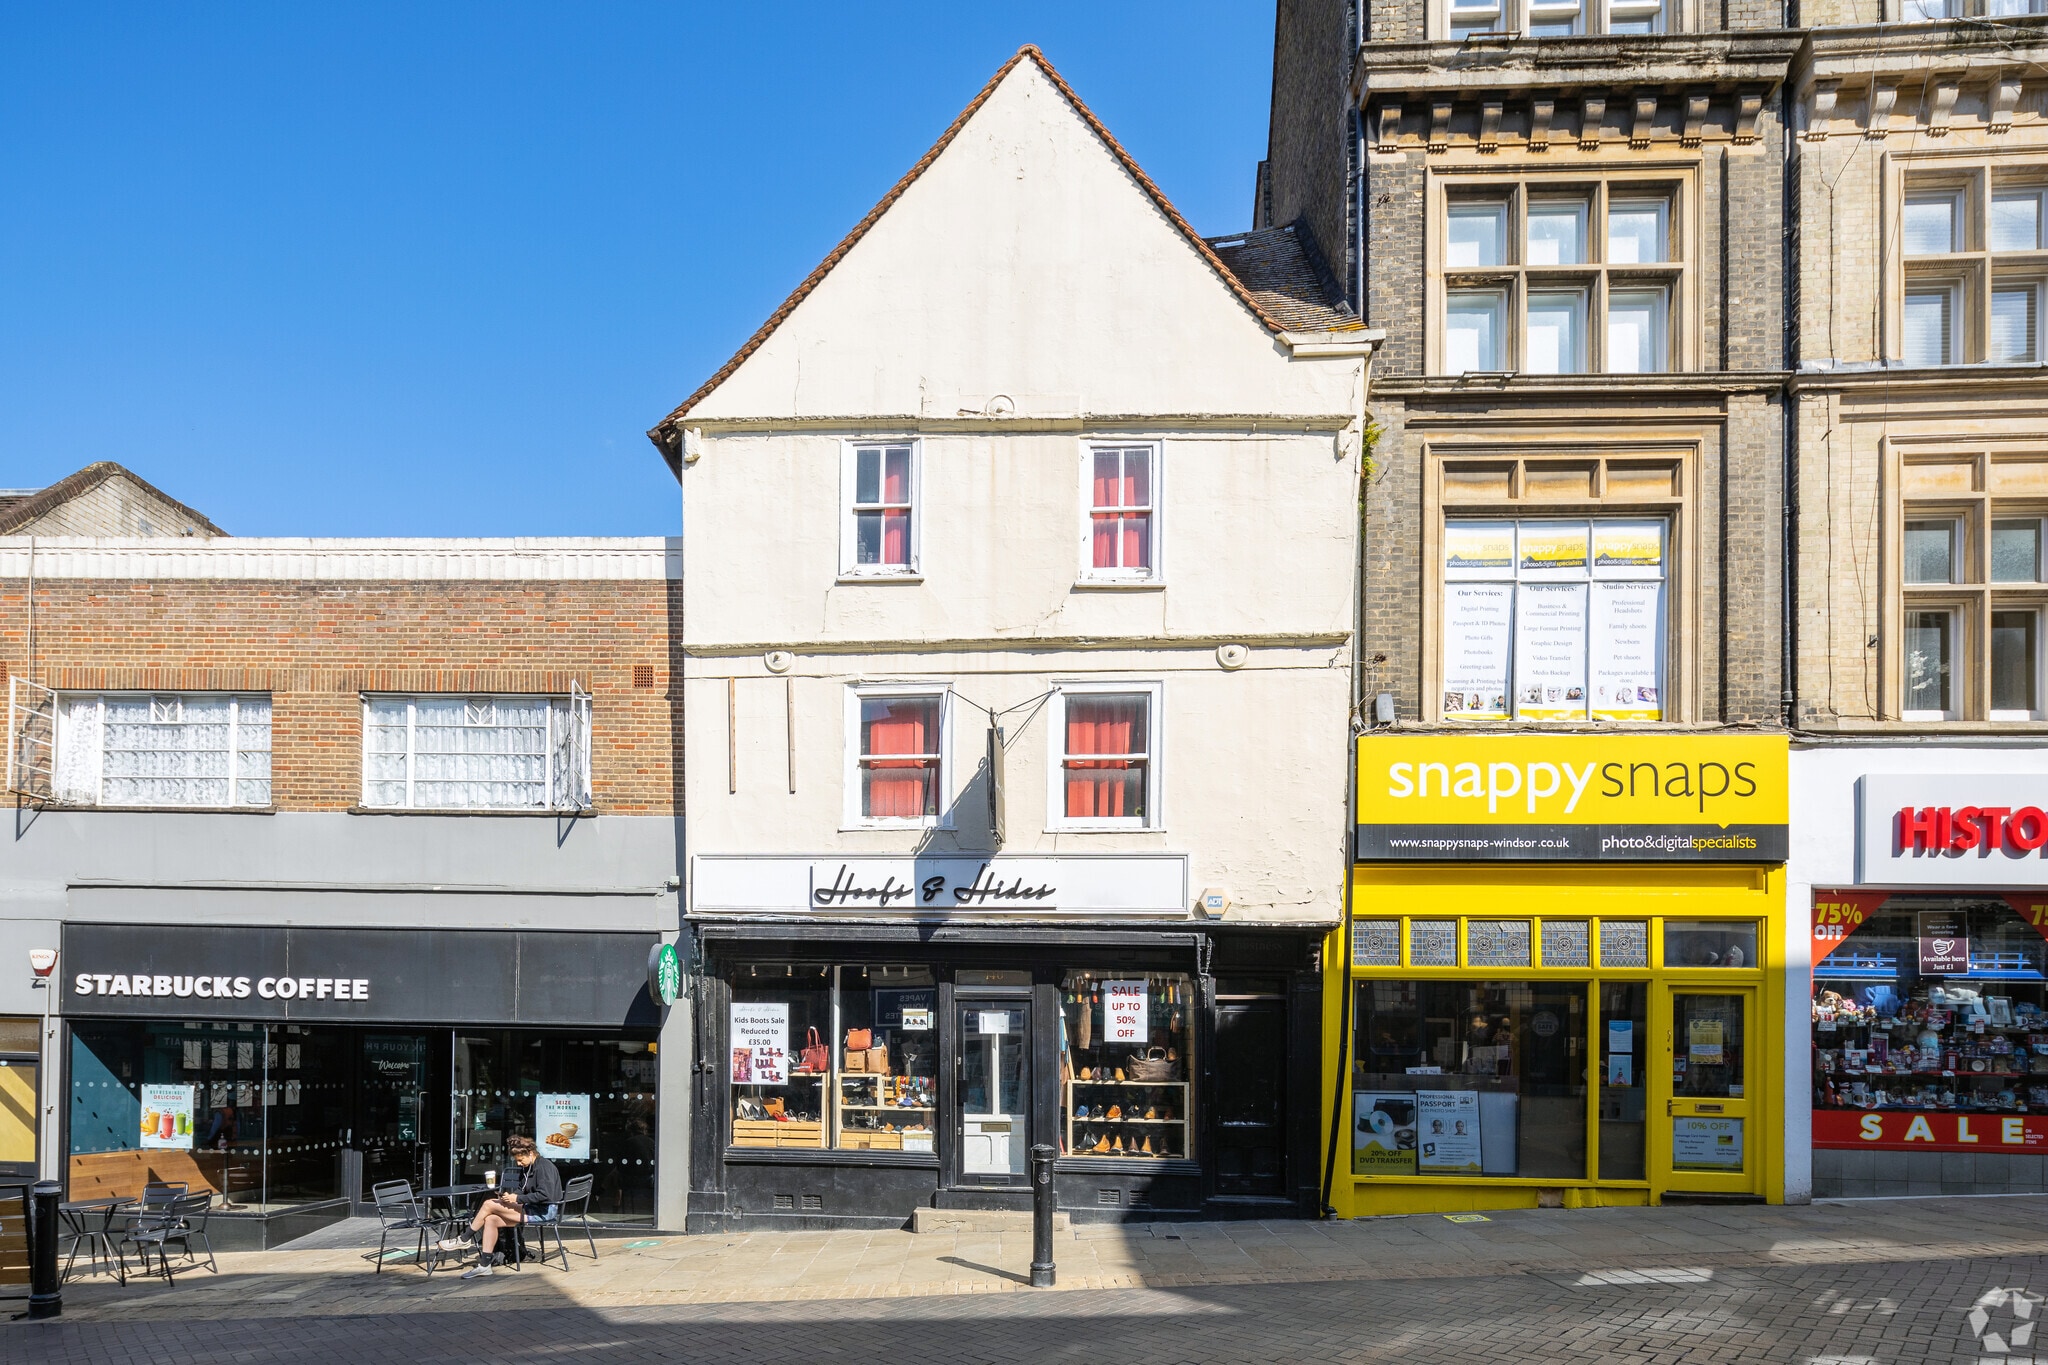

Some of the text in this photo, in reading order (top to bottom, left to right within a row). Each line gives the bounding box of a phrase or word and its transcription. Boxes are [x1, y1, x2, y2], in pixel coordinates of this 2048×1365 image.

[814, 862, 1056, 906] Hoofs & Hides
[1208, 897, 1222, 906] ADT
[1815, 902, 1863, 924] 75%
[1814, 924, 1844, 940] OFF
[75, 974, 369, 1000] STARBUCKS COFFEE
[1112, 986, 1140, 996] SALE
[1112, 1002, 1125, 1010] UP
[1127, 1002, 1140, 1010] TO
[1116, 1016, 1136, 1024] 50%
